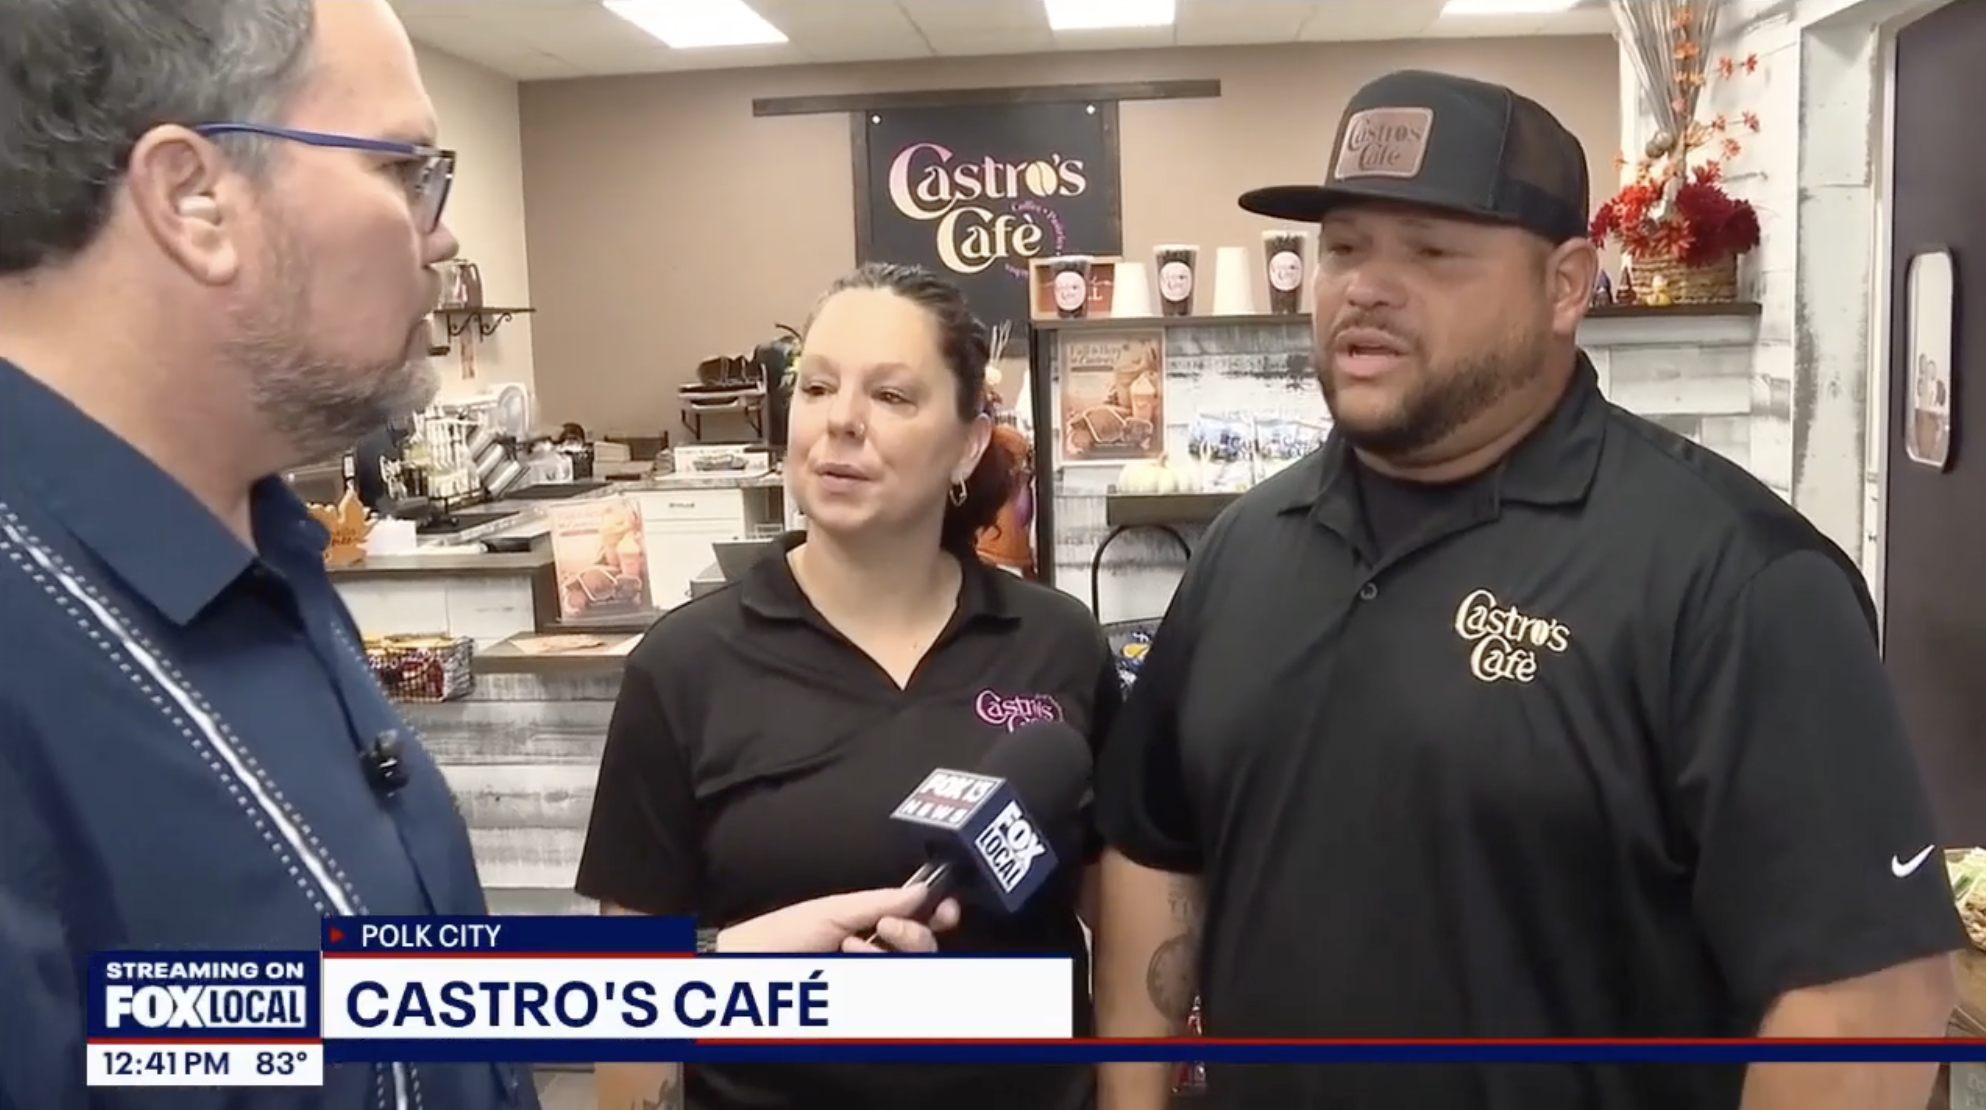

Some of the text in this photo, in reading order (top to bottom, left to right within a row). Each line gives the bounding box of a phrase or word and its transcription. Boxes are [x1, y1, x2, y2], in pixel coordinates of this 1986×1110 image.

[889, 142, 1087, 220] Castro's
[1455, 589, 1570, 652] Castro's
[901, 799, 968, 824] NEWS
[920, 773, 976, 800] FOX
[979, 826, 1022, 887] LOCAL
[998, 800, 1046, 870] FOX
